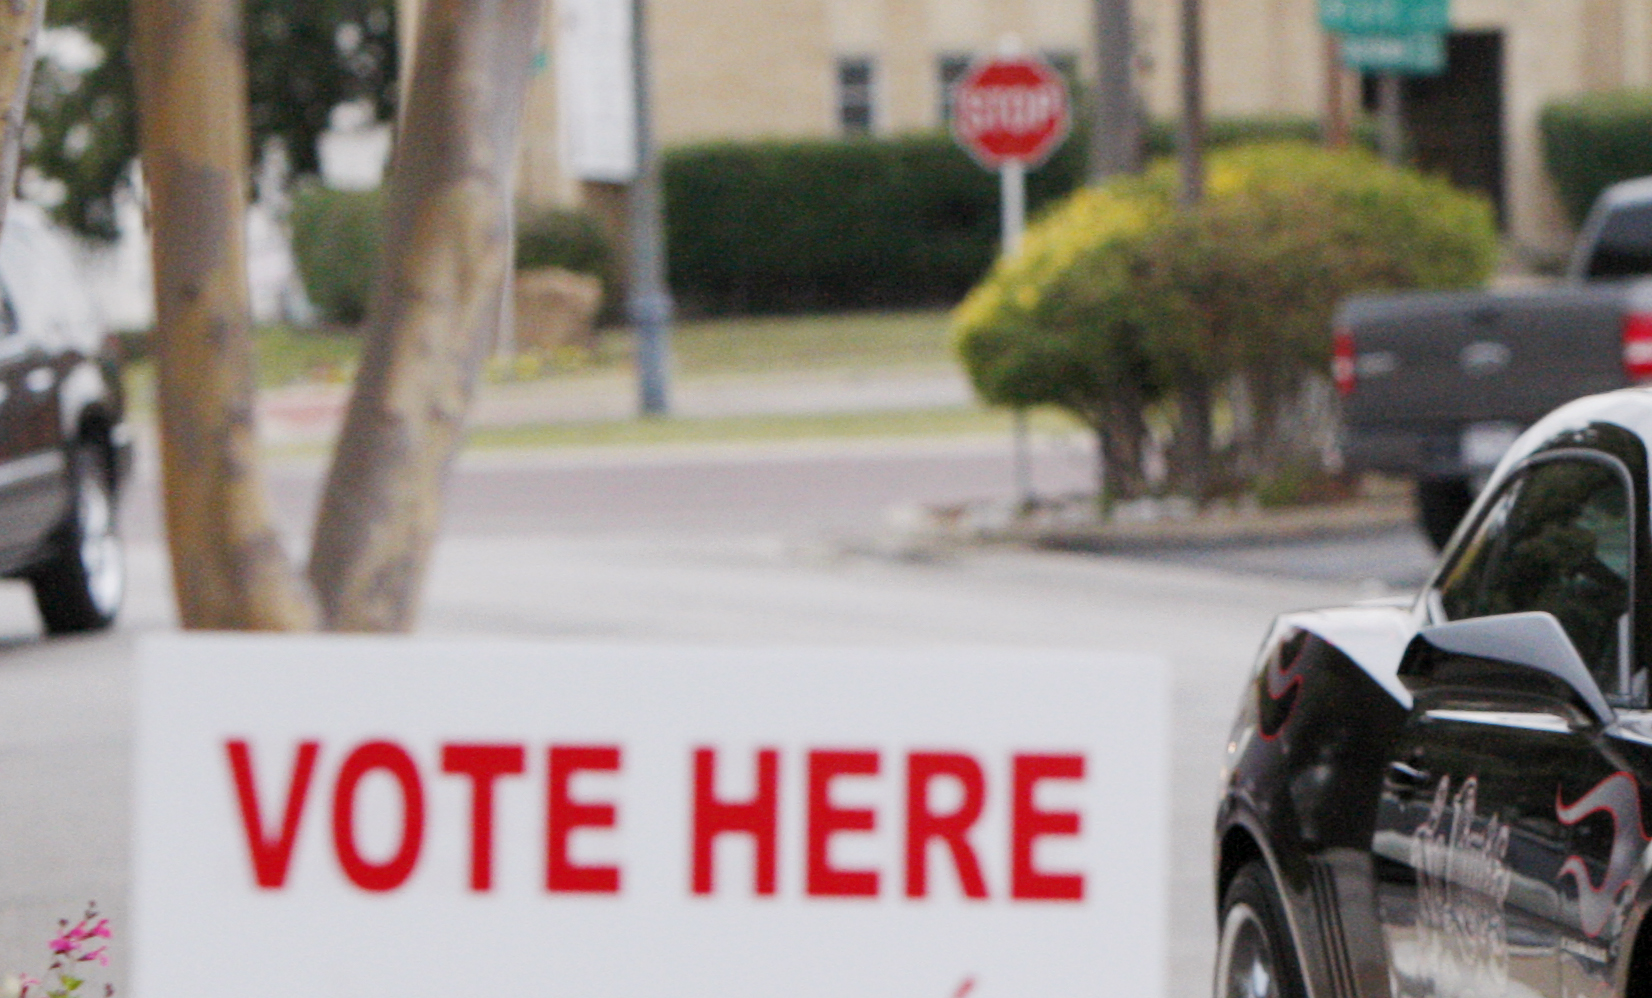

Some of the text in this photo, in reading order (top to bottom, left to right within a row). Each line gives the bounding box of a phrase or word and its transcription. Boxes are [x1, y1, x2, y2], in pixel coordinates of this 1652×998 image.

[964, 88, 1058, 130] STOP
[223, 738, 1087, 902] VOTE HERE
